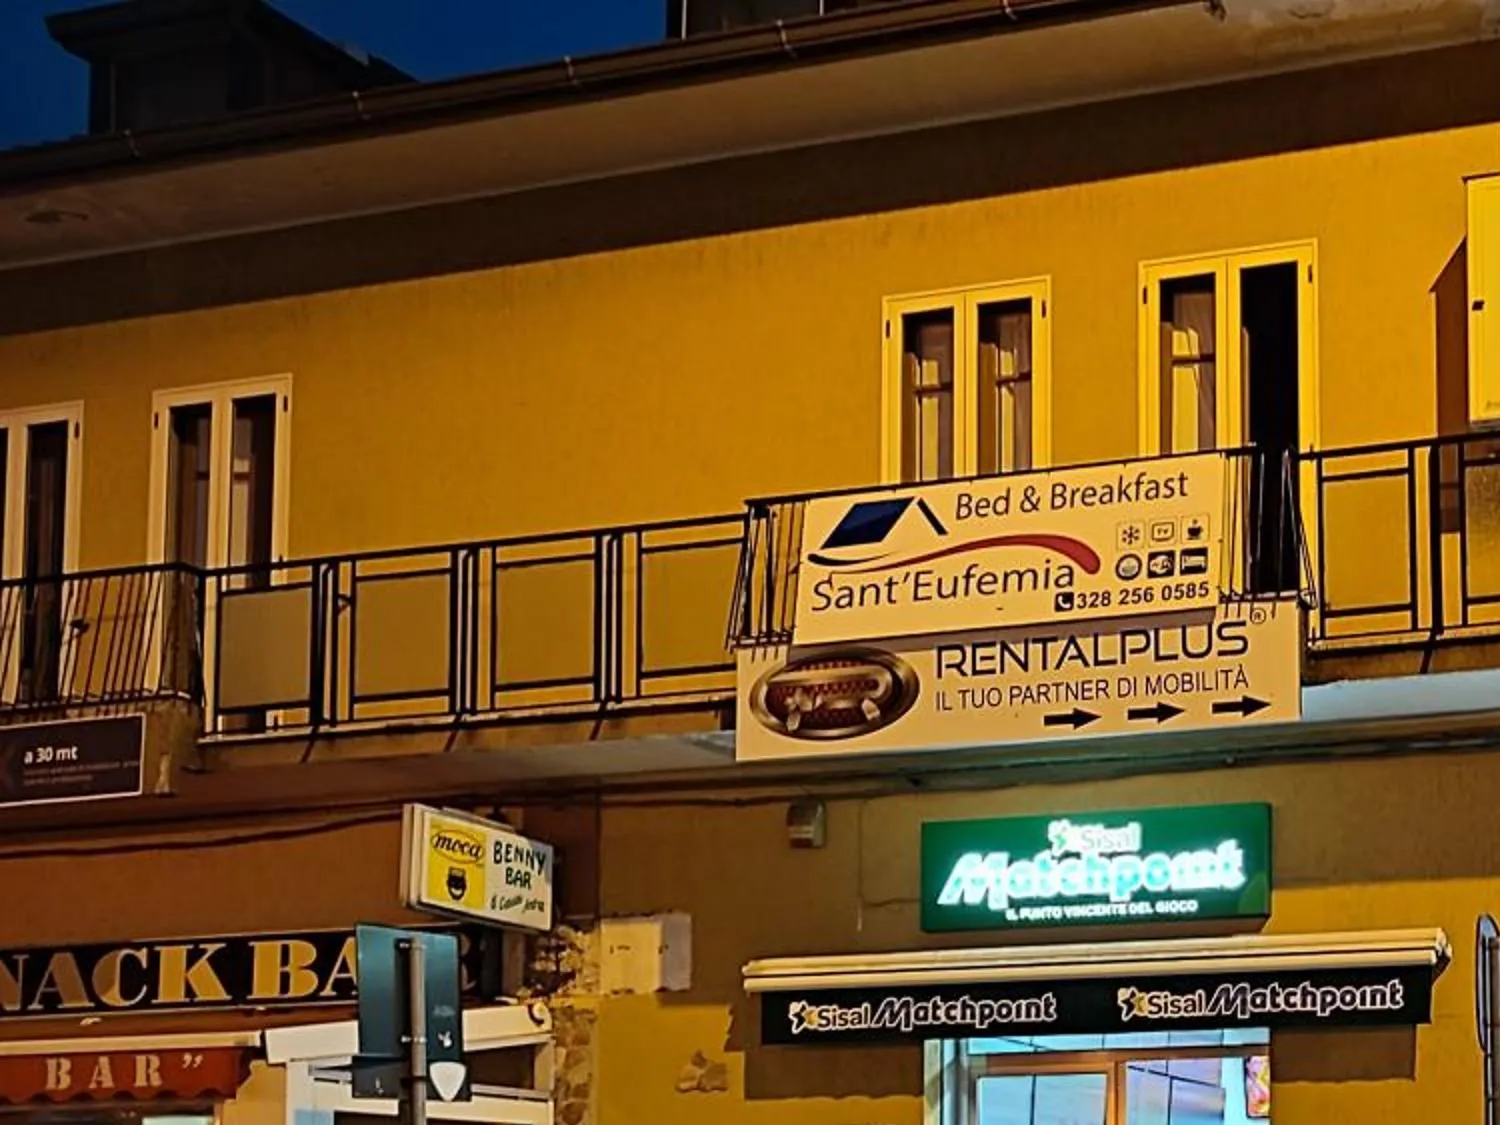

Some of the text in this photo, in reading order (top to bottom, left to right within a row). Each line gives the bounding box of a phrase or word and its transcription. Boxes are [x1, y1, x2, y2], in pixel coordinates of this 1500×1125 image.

[956, 471, 1189, 521] Bed & Breakfast
[811, 559, 1075, 612] Sant'Eufemia
[1076, 581, 1209, 609] 328 256 0585
[936, 620, 1249, 680] RENTALPLUS
[935, 663, 1250, 712] IL TUO PARTNER DI MOBILITÀ
[36, 746, 54, 762] 30
[56, 745, 79, 760] mt
[1080, 823, 1141, 852] Sisal
[493, 838, 547, 877] BENNY
[937, 840, 1246, 909] Matchpoint
[505, 866, 532, 891] BAR
[1155, 899, 1199, 914] GIOCO
[816, 993, 1057, 1031] Sisal Matchpoint
[1147, 979, 1404, 1018] Sisal Matchpoint
